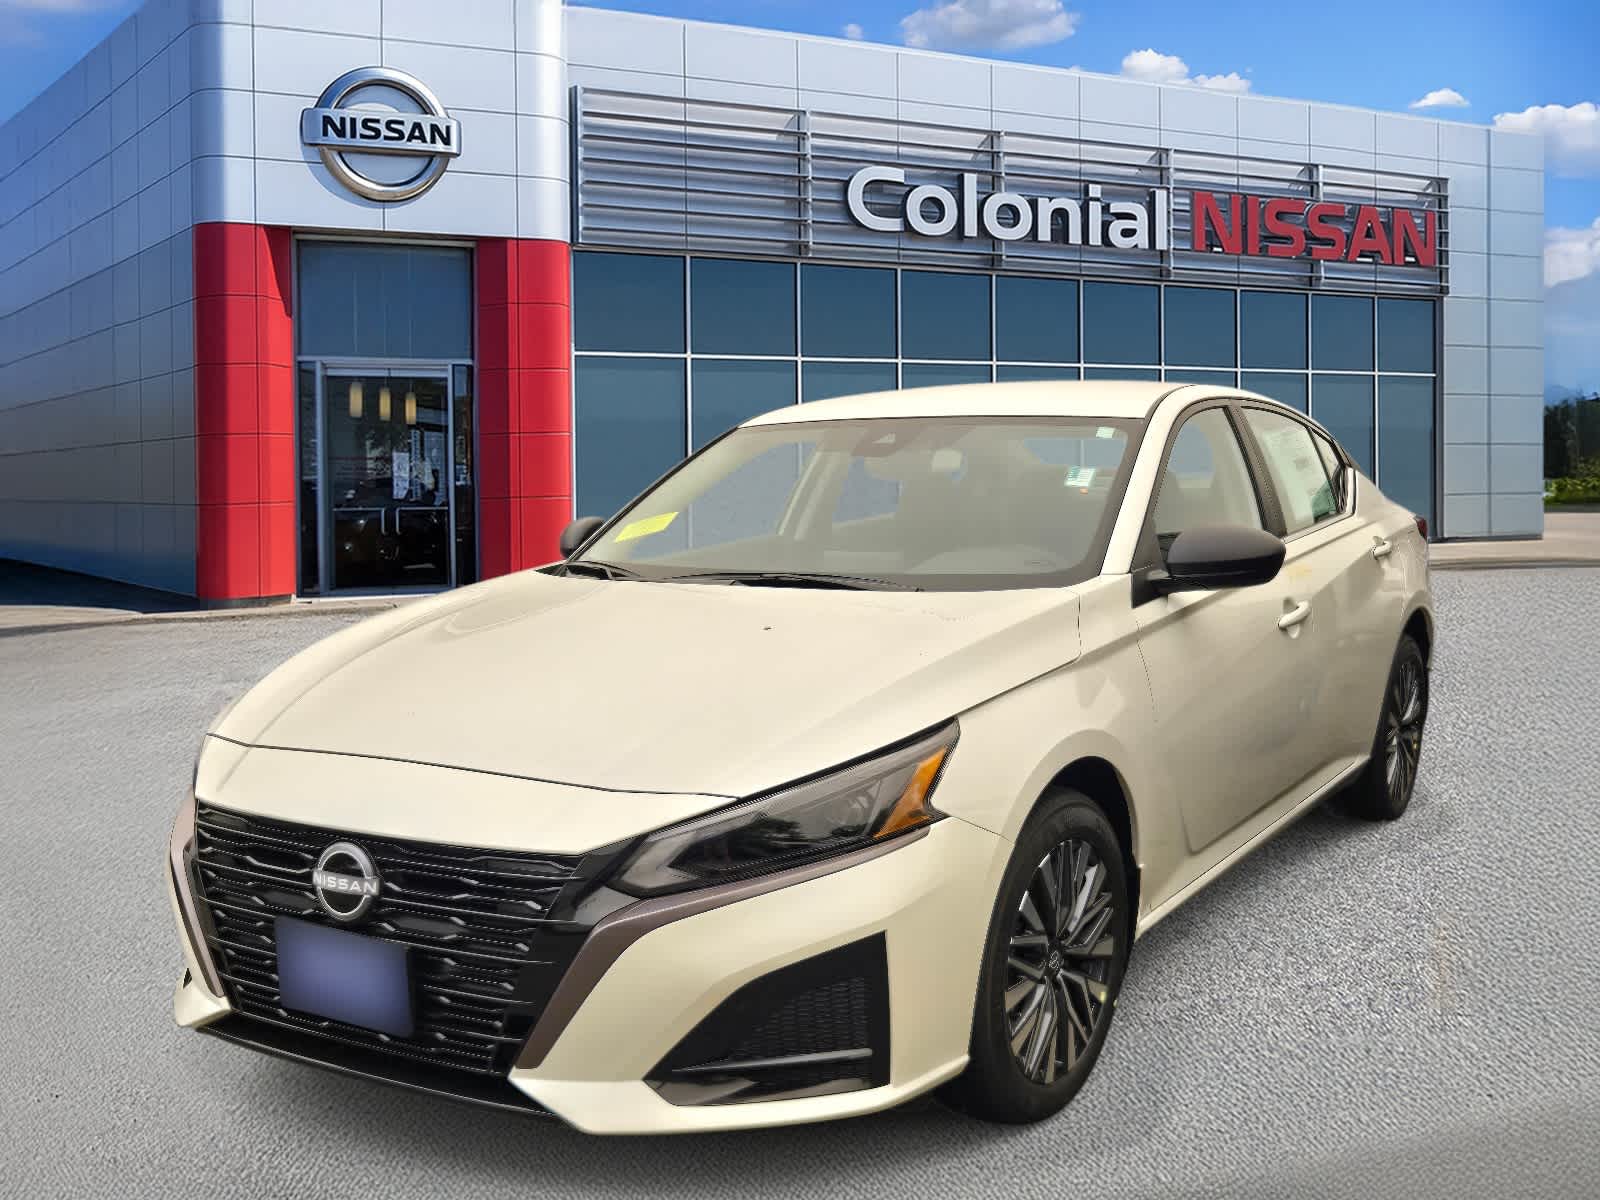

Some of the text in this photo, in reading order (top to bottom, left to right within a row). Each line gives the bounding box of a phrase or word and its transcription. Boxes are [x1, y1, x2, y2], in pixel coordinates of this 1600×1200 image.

[322, 115, 452, 146] NISSAN
[847, 165, 1437, 267] Colonial NISSAN
[313, 870, 377, 894] NISSAN
